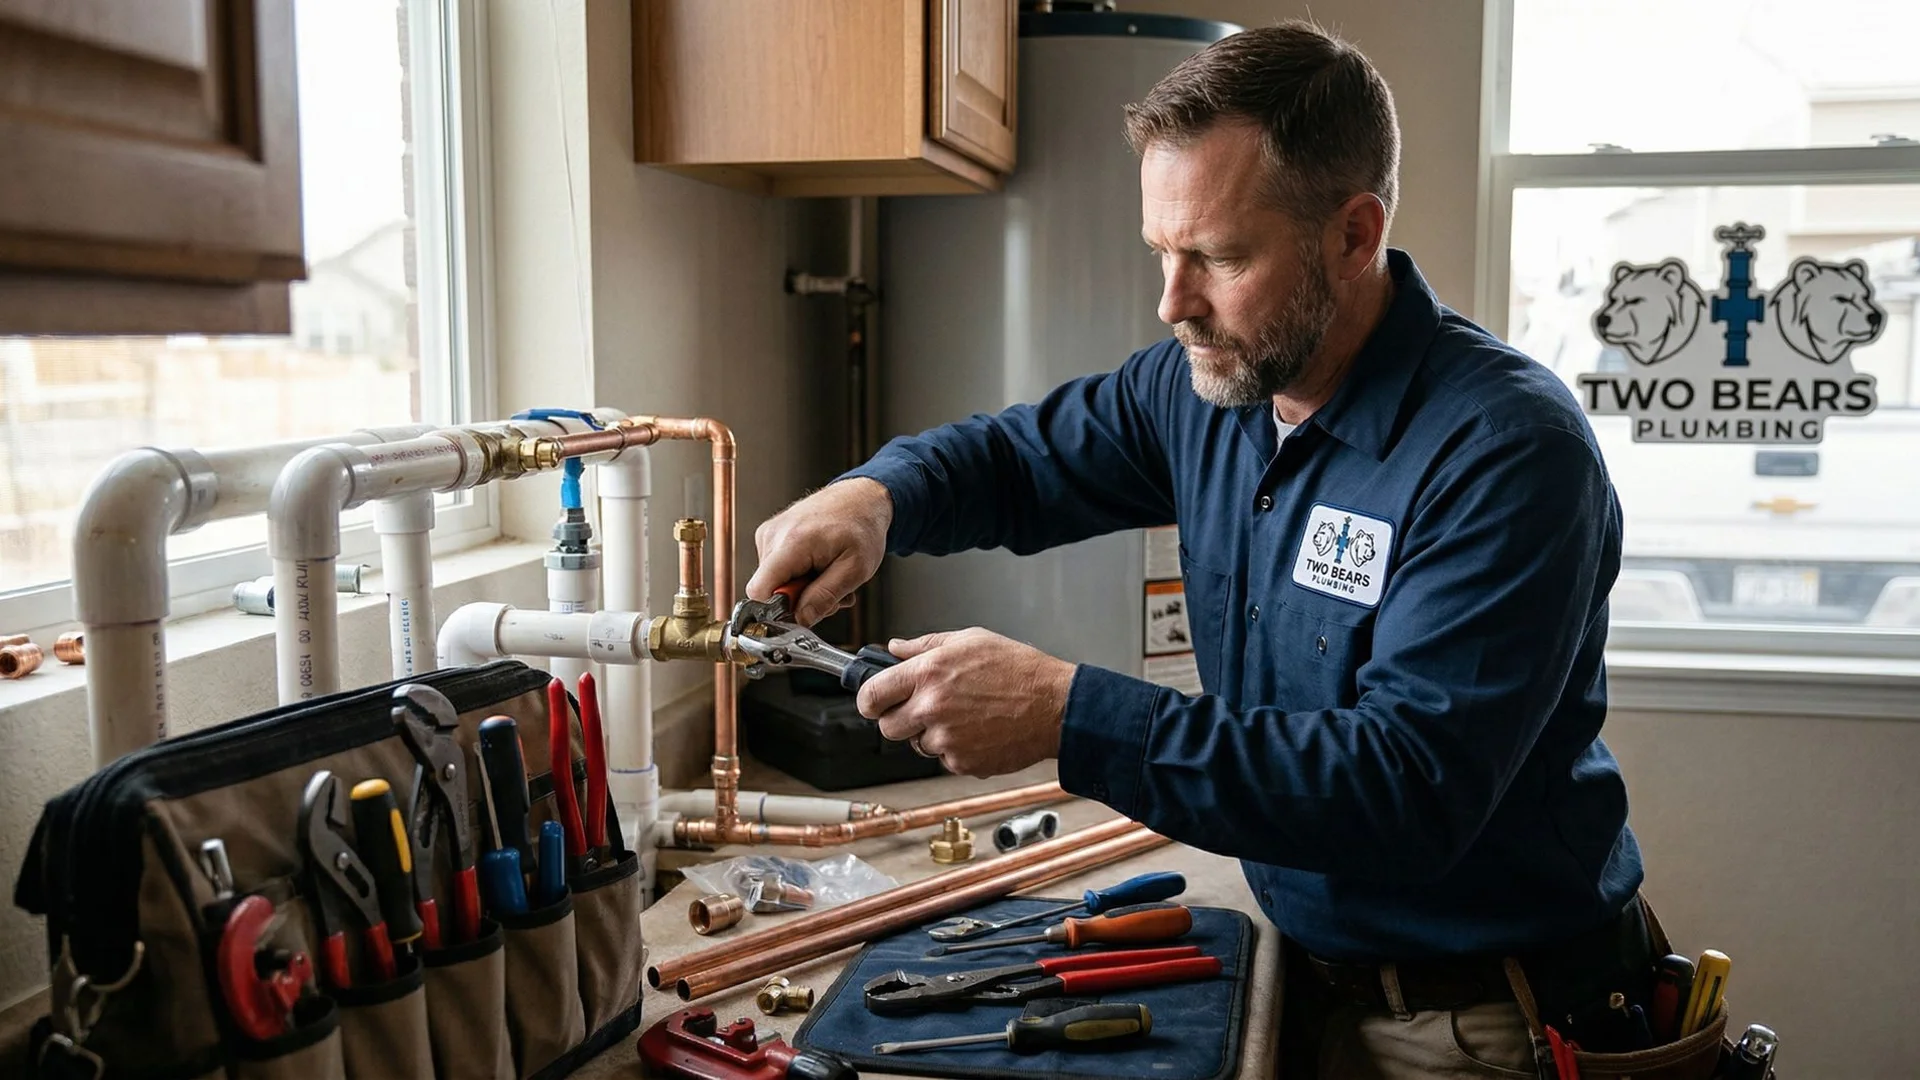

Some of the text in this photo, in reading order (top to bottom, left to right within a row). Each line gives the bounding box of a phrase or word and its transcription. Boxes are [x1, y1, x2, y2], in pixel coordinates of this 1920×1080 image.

[1582, 378, 1872, 411] TWO BEARS
[1636, 419, 1820, 440] PLUMBING
[1307, 559, 1370, 587] TWO BEARS
[1312, 575, 1355, 593] PLUMBING
